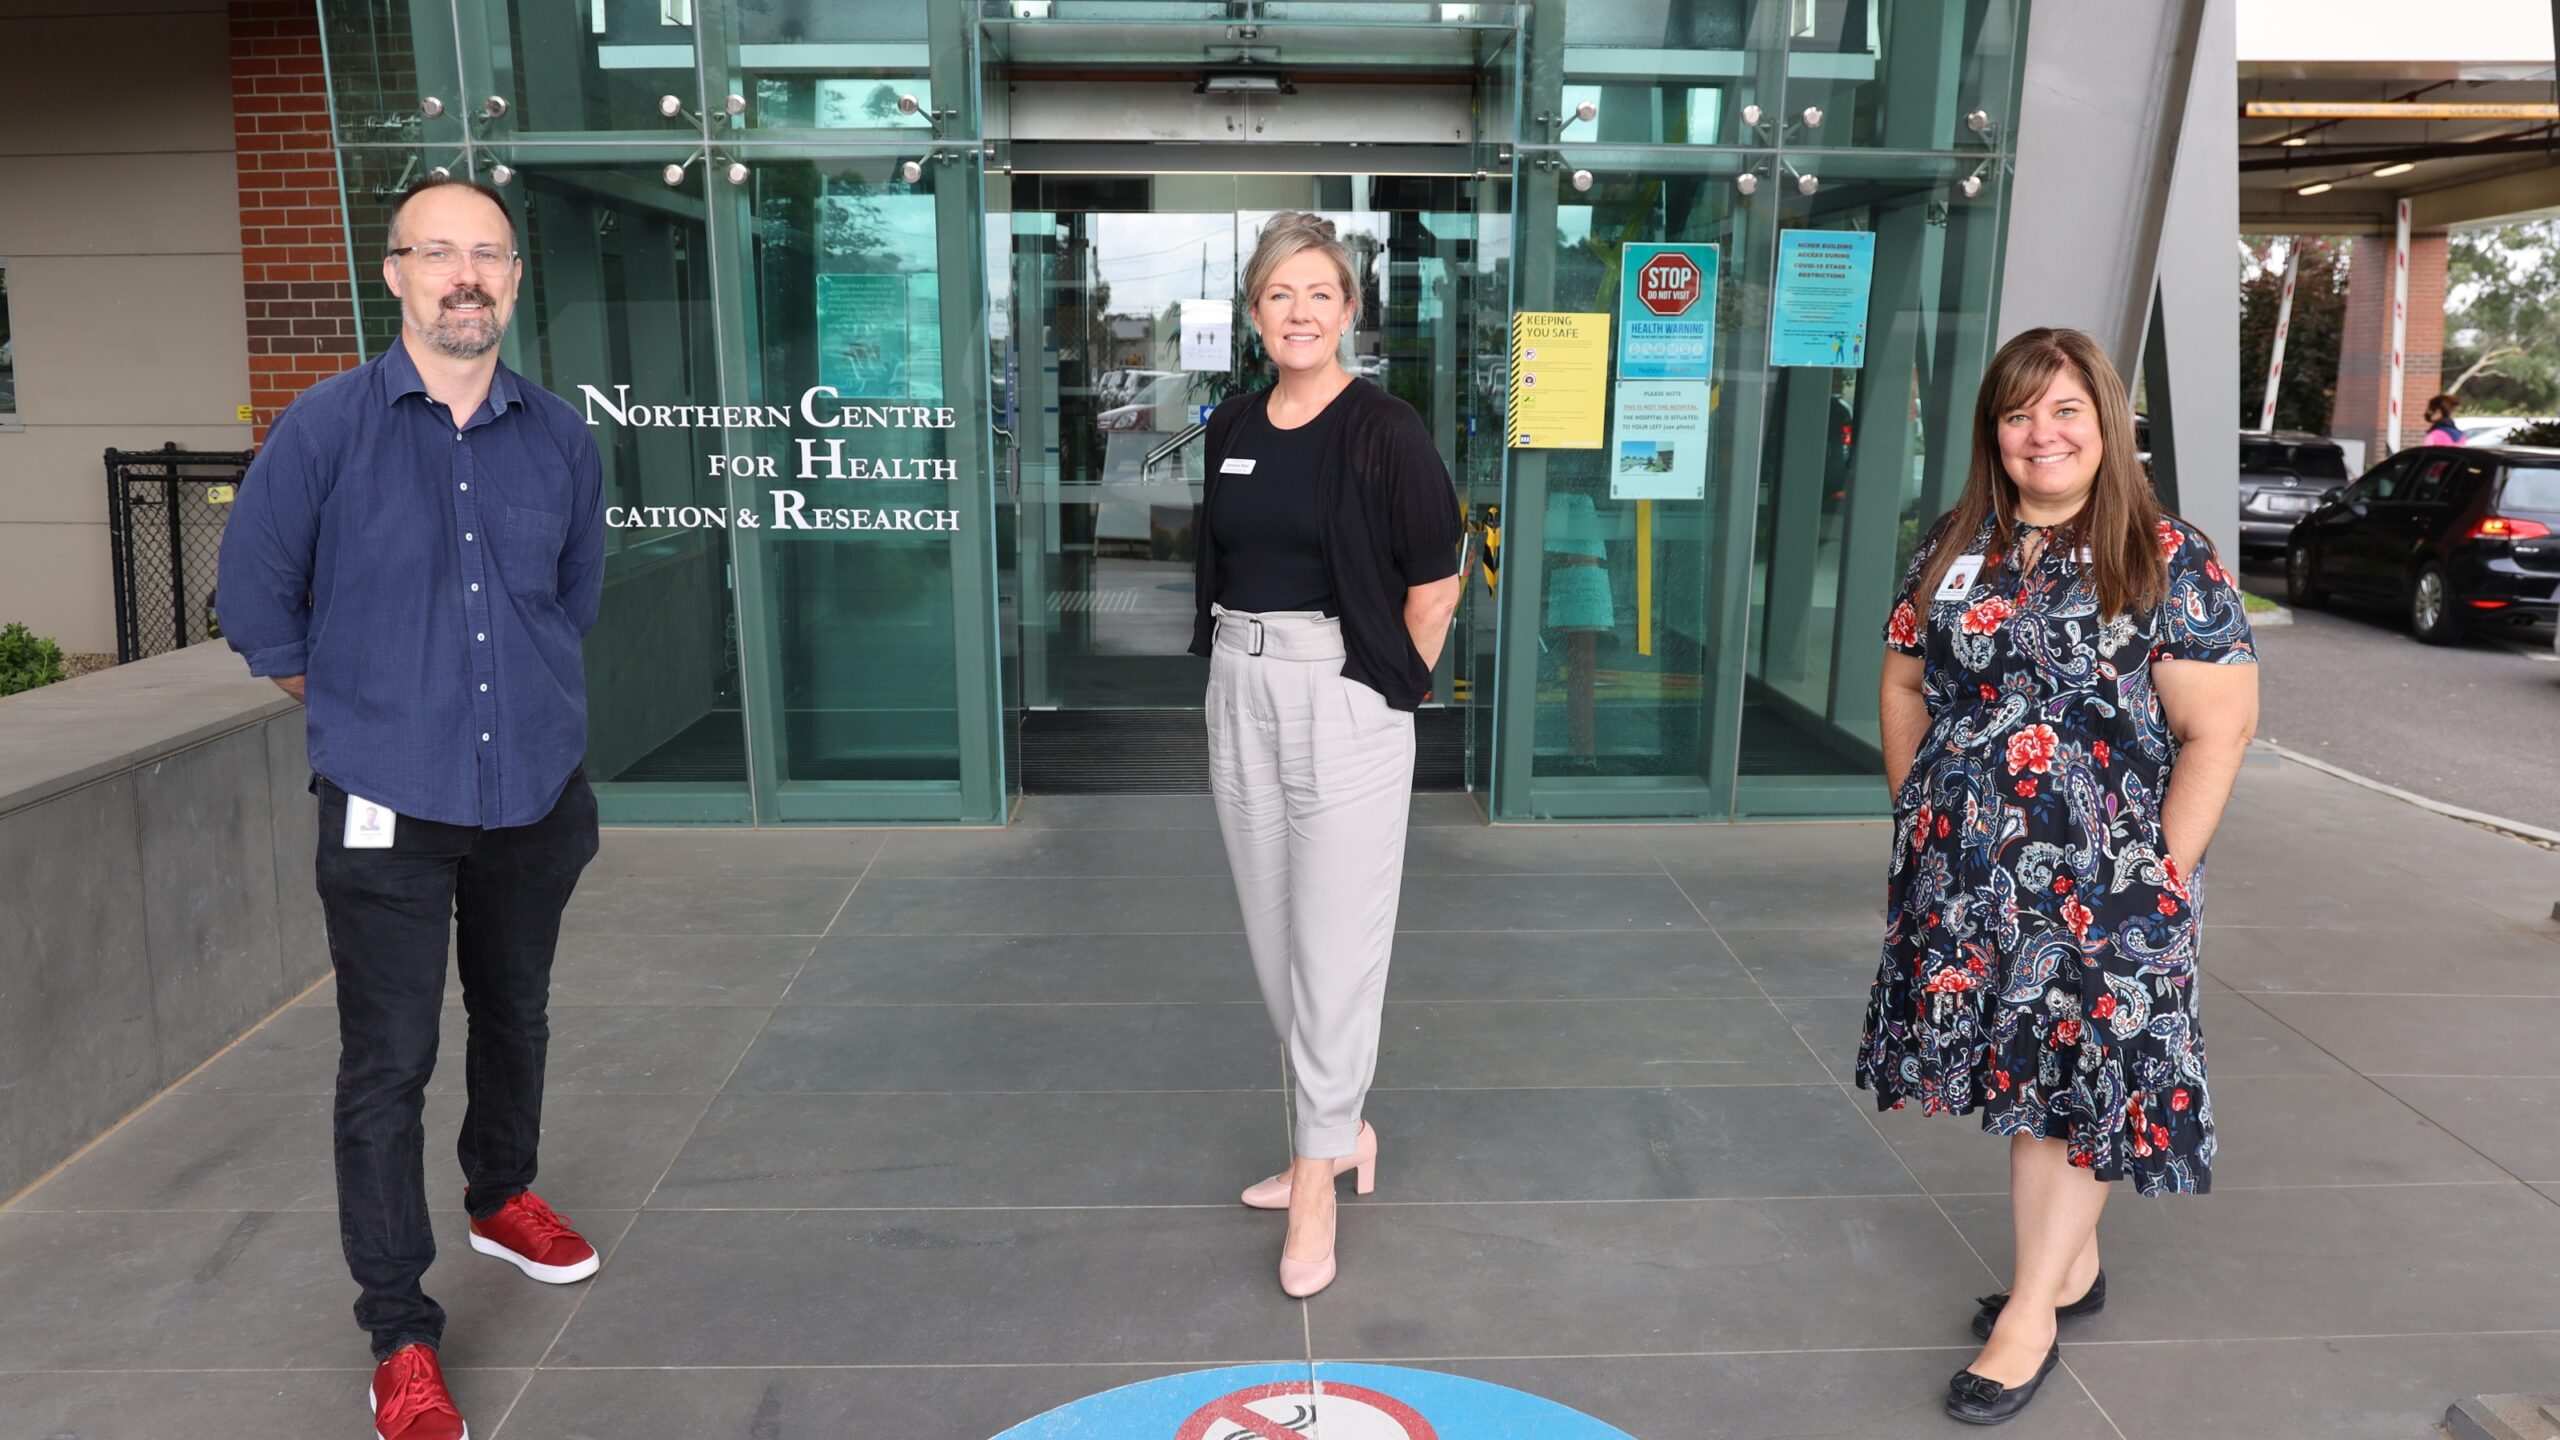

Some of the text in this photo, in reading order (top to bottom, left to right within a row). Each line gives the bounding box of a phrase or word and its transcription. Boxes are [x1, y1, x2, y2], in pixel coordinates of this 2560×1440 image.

[1648, 267, 1692, 289] STOP
[1647, 291, 1690, 300] DO NOT VISIT
[1527, 316, 1572, 326] KEEPING
[1631, 323, 1704, 334] HEALTH WARNING
[1527, 328, 1579, 338] YOU SAFE
[577, 384, 956, 428] NORTHERN CENTRE
[708, 438, 958, 480] FOR HEALTH
[605, 490, 960, 532] CATION & RESEARCH
